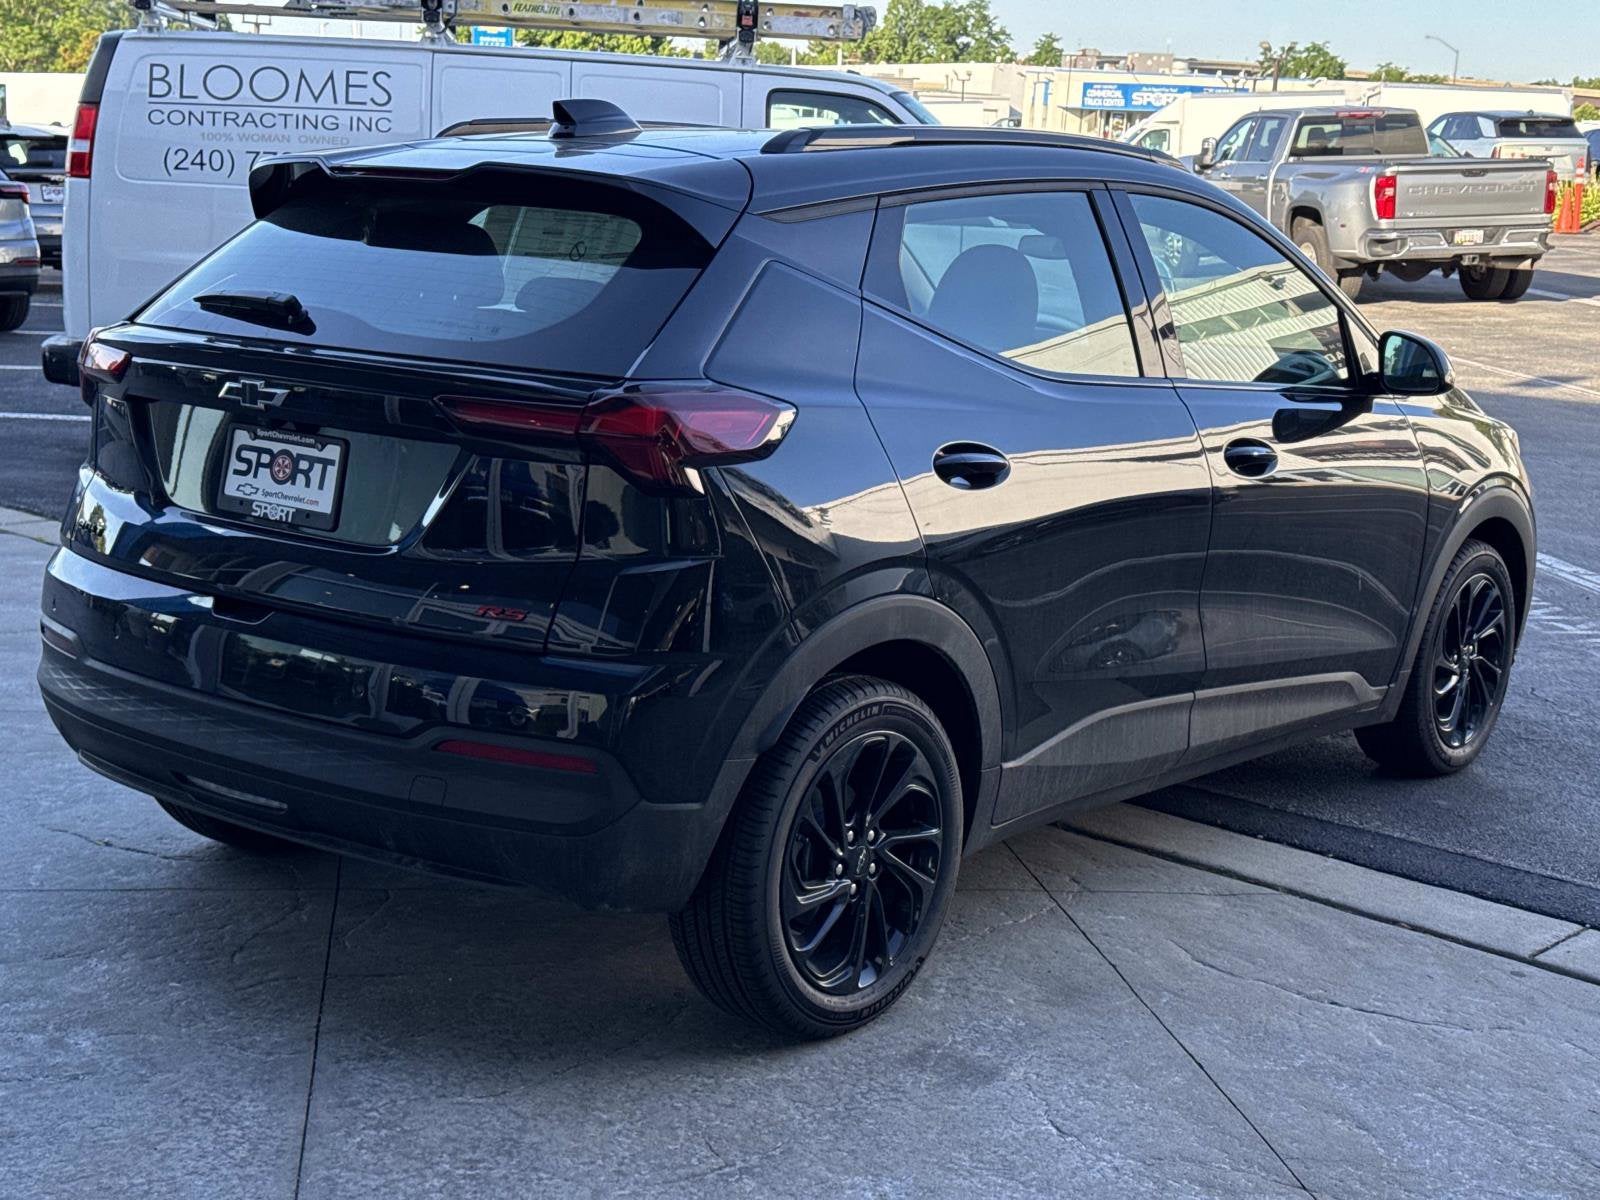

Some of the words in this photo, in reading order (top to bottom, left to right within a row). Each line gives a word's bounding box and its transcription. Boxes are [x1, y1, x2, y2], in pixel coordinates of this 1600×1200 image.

[148, 63, 393, 107] BLOOMES
[147, 109, 340, 131] CONTRACTING
[349, 115, 392, 133] INC
[201, 131, 234, 142] 100%
[237, 132, 291, 144] WOMAN
[298, 134, 350, 146] OWNED
[163, 147, 235, 178] (240)
[1408, 183, 1537, 197] CHEVROLET
[256, 428, 315, 444] SportChevrolet.com
[232, 444, 336, 491] SPORT
[261, 488, 320, 506] SportChevrolet.com
[251, 501, 296, 523] SPORT
[476, 605, 526, 620] RS
[825, 705, 880, 746] MICHELIN
